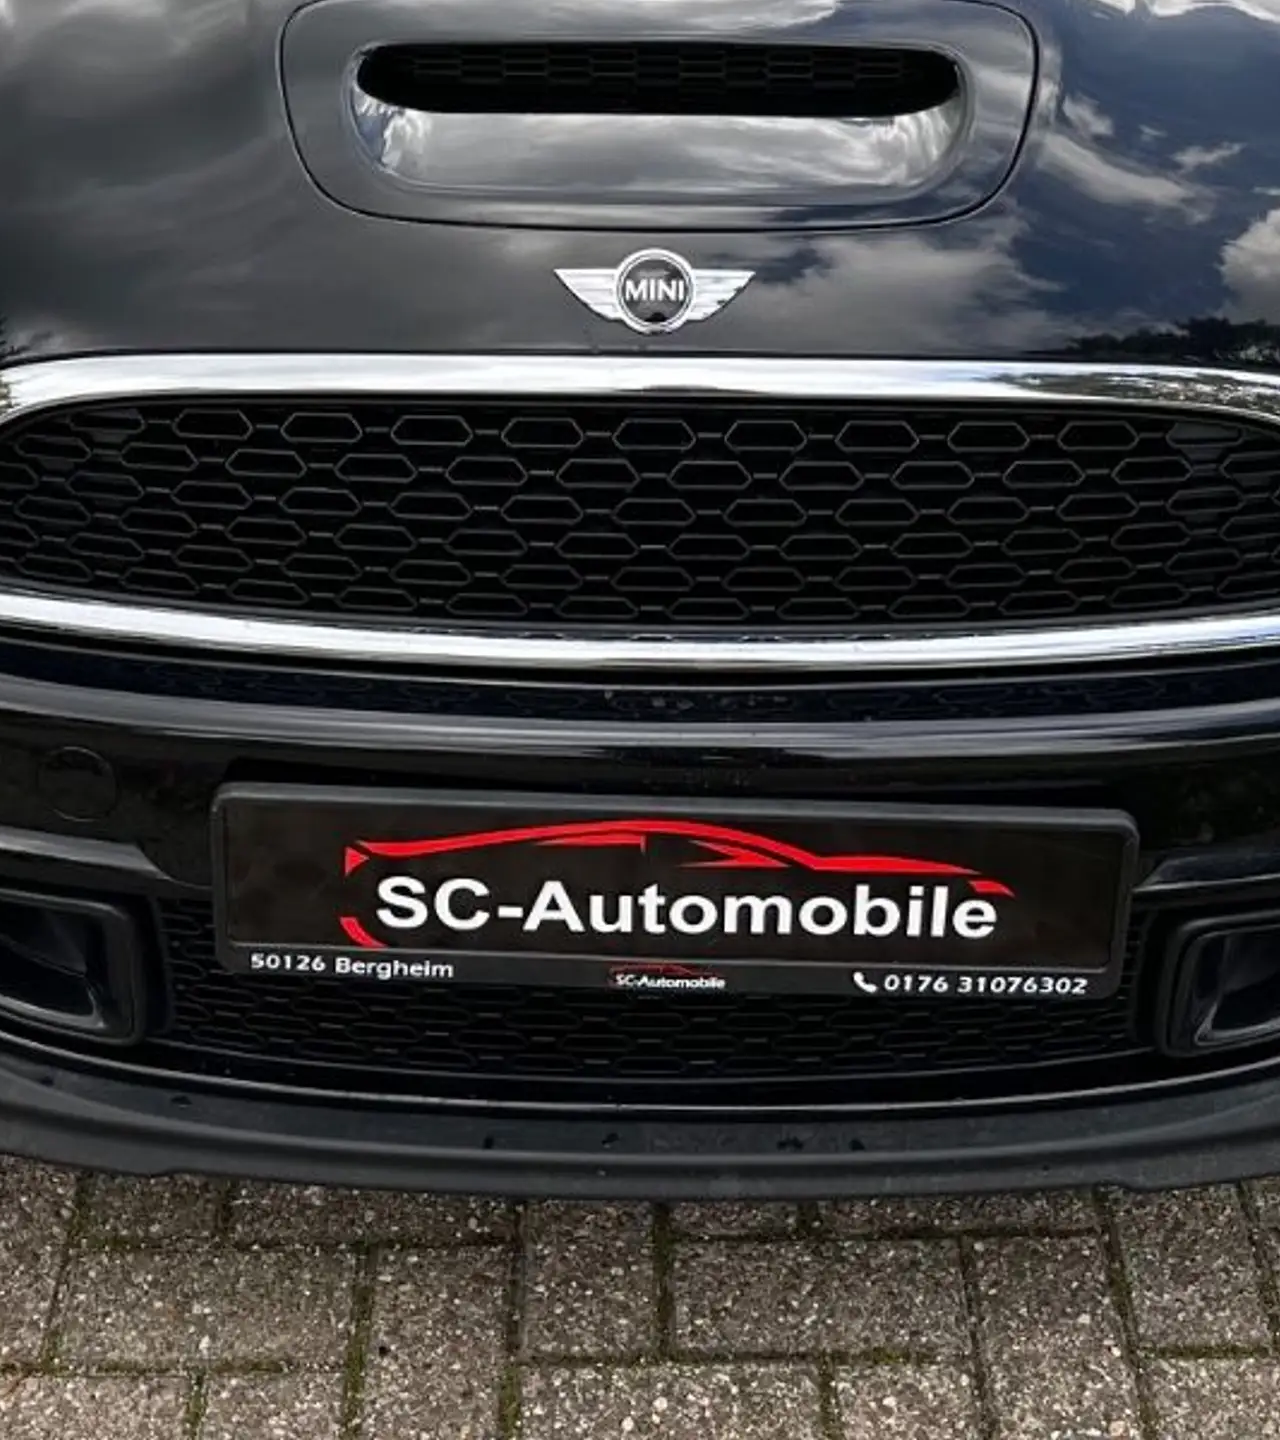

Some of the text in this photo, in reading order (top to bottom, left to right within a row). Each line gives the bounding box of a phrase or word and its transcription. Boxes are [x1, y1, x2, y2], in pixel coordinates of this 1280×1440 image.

[625, 278, 685, 302] MINI
[375, 875, 998, 939] SC-Automobile
[250, 952, 455, 981] 50126 Bergheim
[614, 972, 727, 990] SC-Automobile
[883, 973, 1089, 996] 0176 31076302
